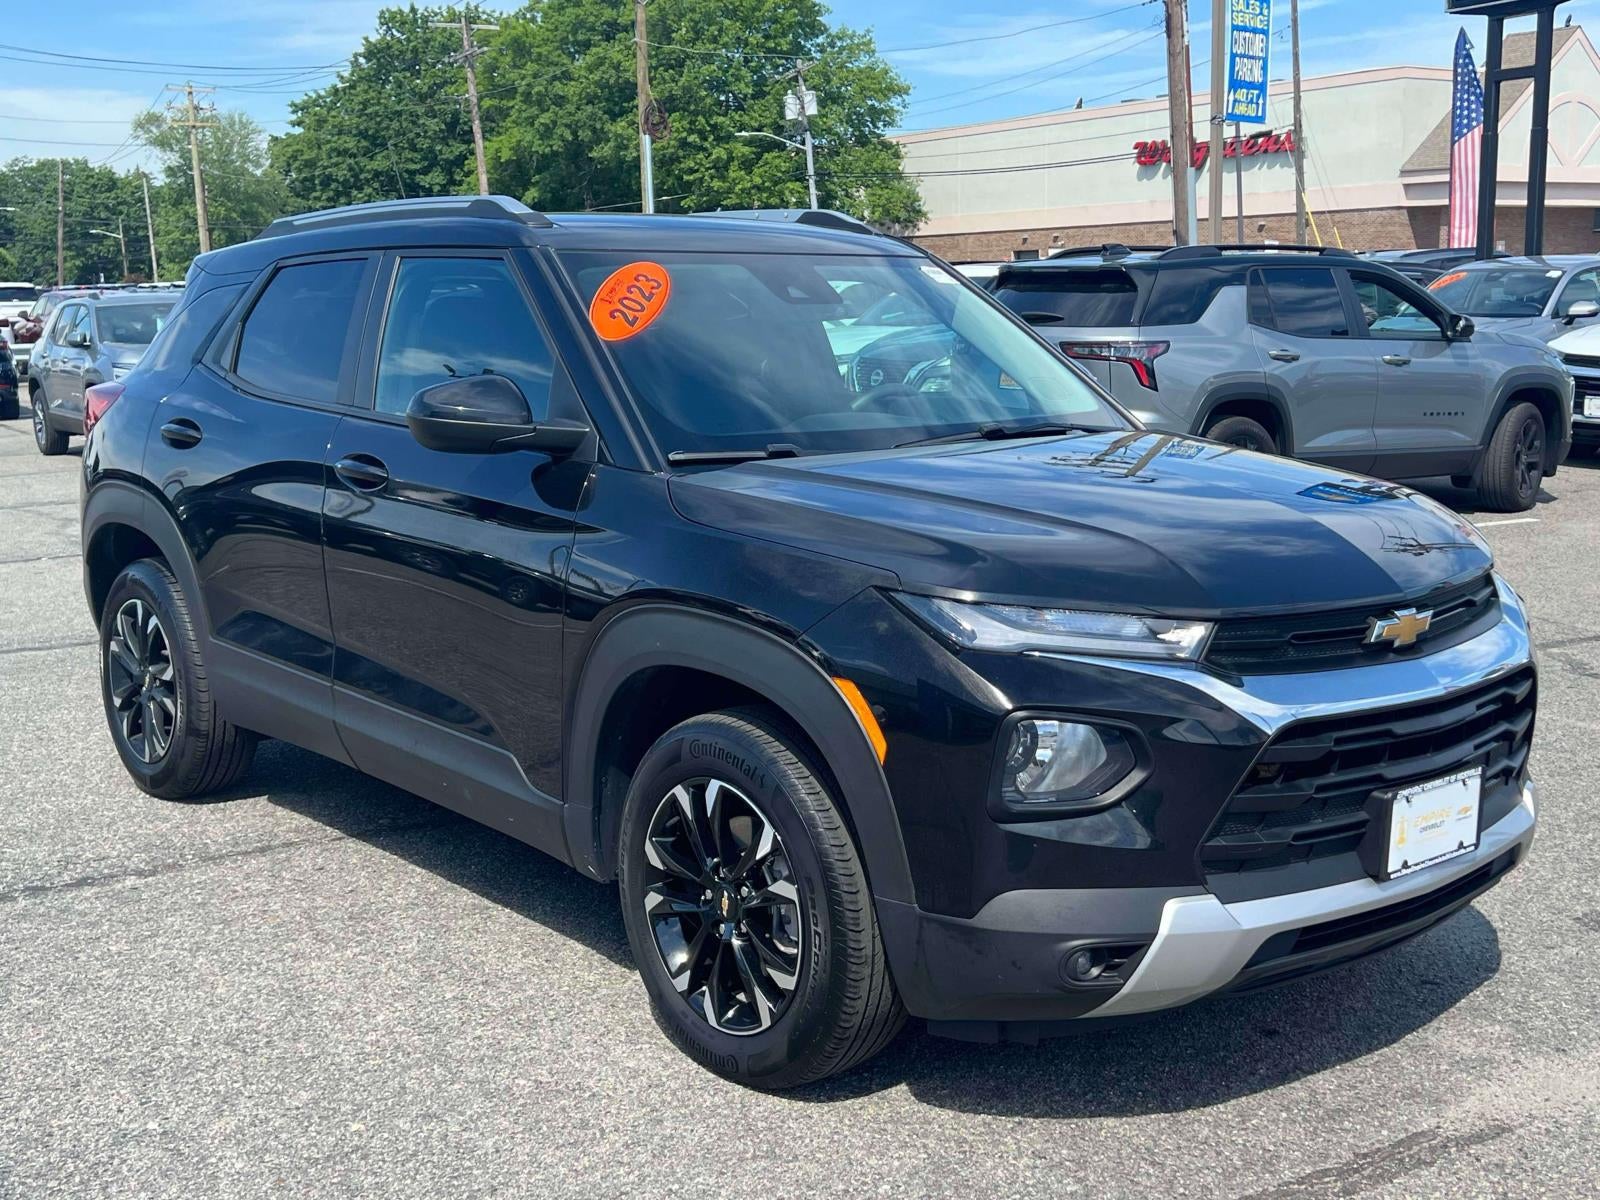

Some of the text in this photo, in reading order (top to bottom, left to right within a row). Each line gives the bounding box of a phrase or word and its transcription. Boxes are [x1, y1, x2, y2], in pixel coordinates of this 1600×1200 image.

[1232, 0, 1260, 14] SALES
[1232, 12, 1268, 29] SERVICE
[1232, 30, 1266, 57] CUSTOMER
[1234, 57, 1264, 83] PARKING
[1235, 88, 1260, 103] 40 FT
[1233, 102, 1257, 117] AHEAD
[609, 273, 662, 328] 2023
[689, 740, 757, 780] Continental
